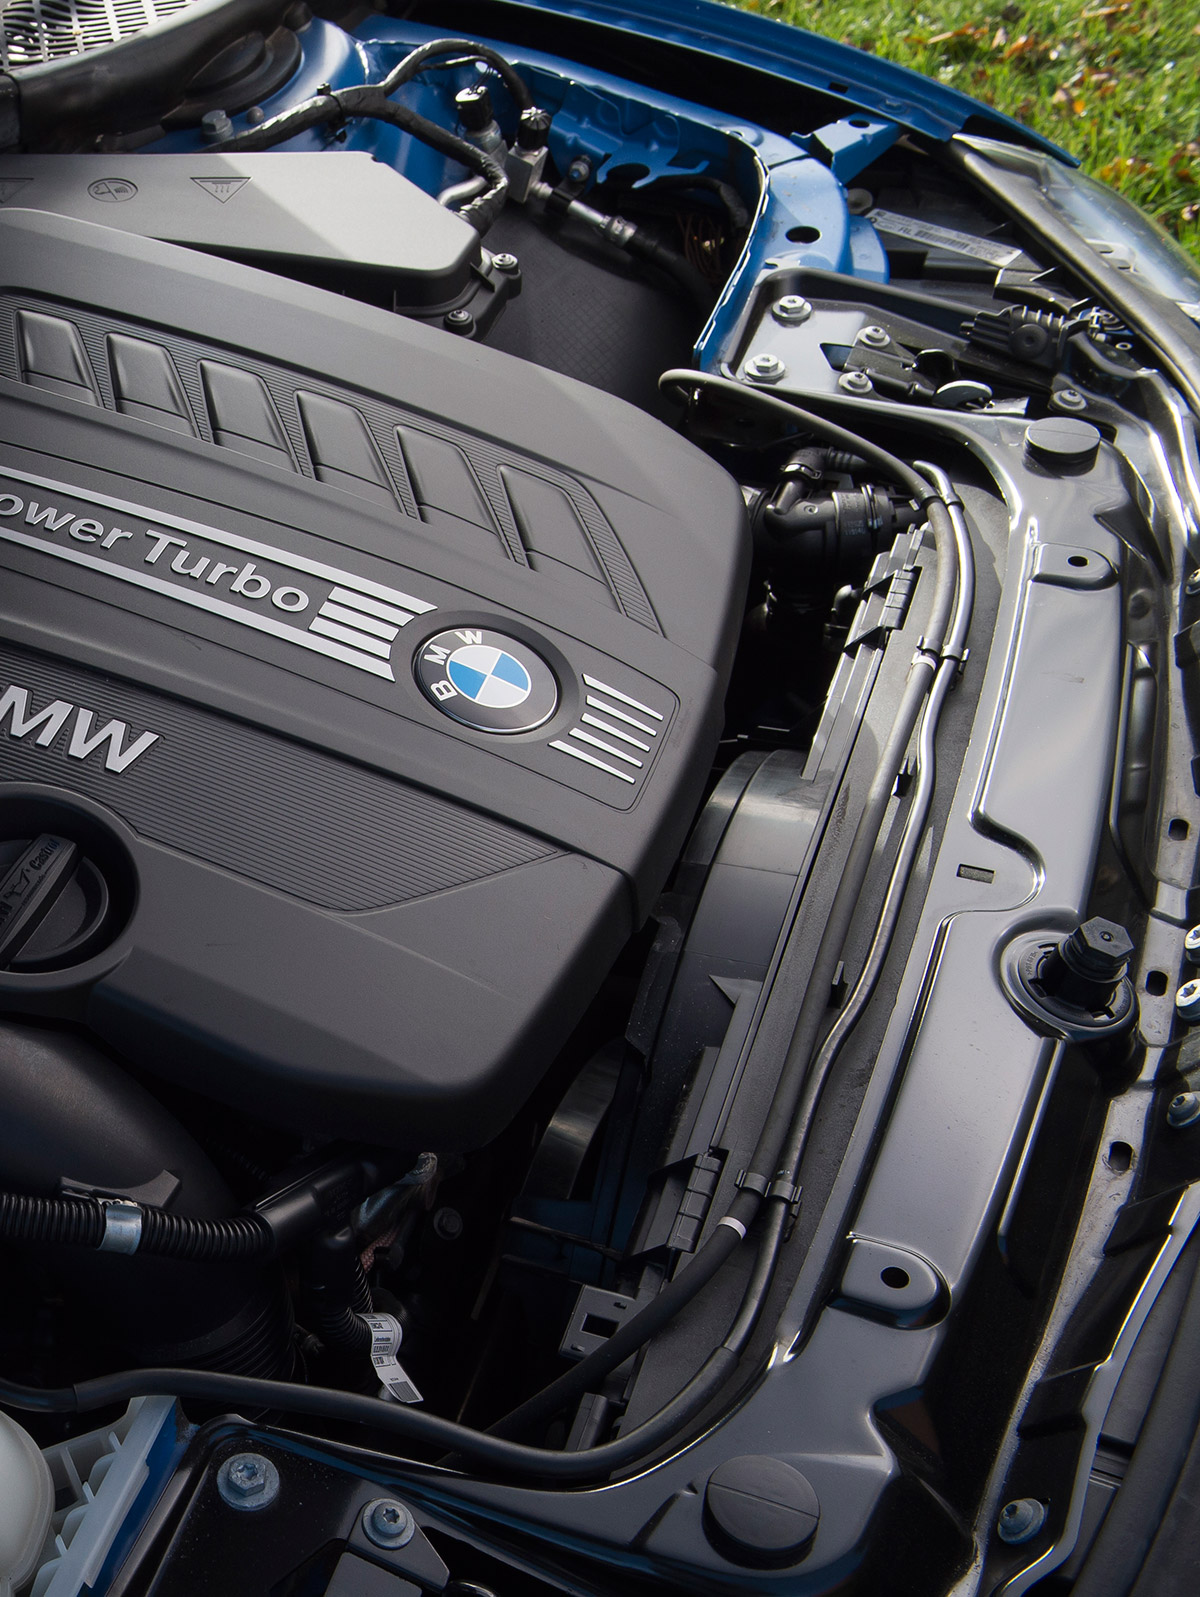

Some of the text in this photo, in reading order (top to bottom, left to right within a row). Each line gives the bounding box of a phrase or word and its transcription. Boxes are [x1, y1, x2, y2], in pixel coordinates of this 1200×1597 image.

[144, 529, 309, 612] Turbo
[423, 630, 482, 701] BMW
[29, 839, 60, 871] Castrol
